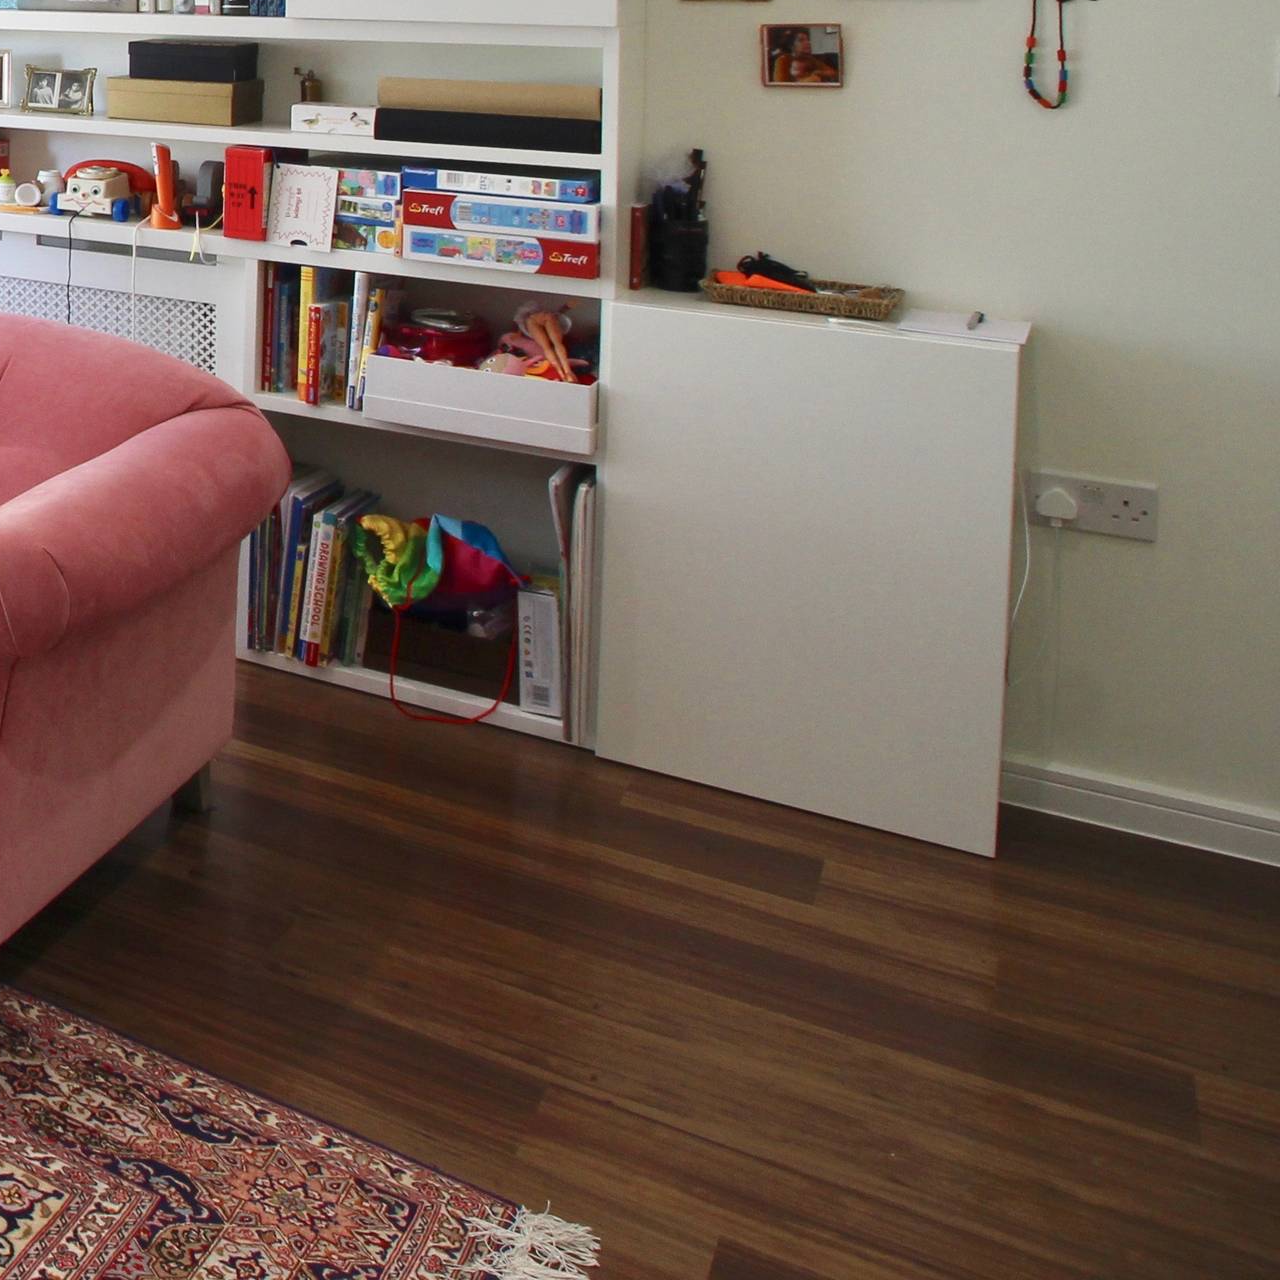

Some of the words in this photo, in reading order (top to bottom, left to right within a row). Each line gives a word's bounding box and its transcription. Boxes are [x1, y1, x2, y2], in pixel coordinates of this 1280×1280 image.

[421, 204, 445, 216] Trefl
[562, 253, 588, 265] Trefl
[316, 542, 330, 585] DRAWING
[310, 585, 324, 627] SCHOOL
